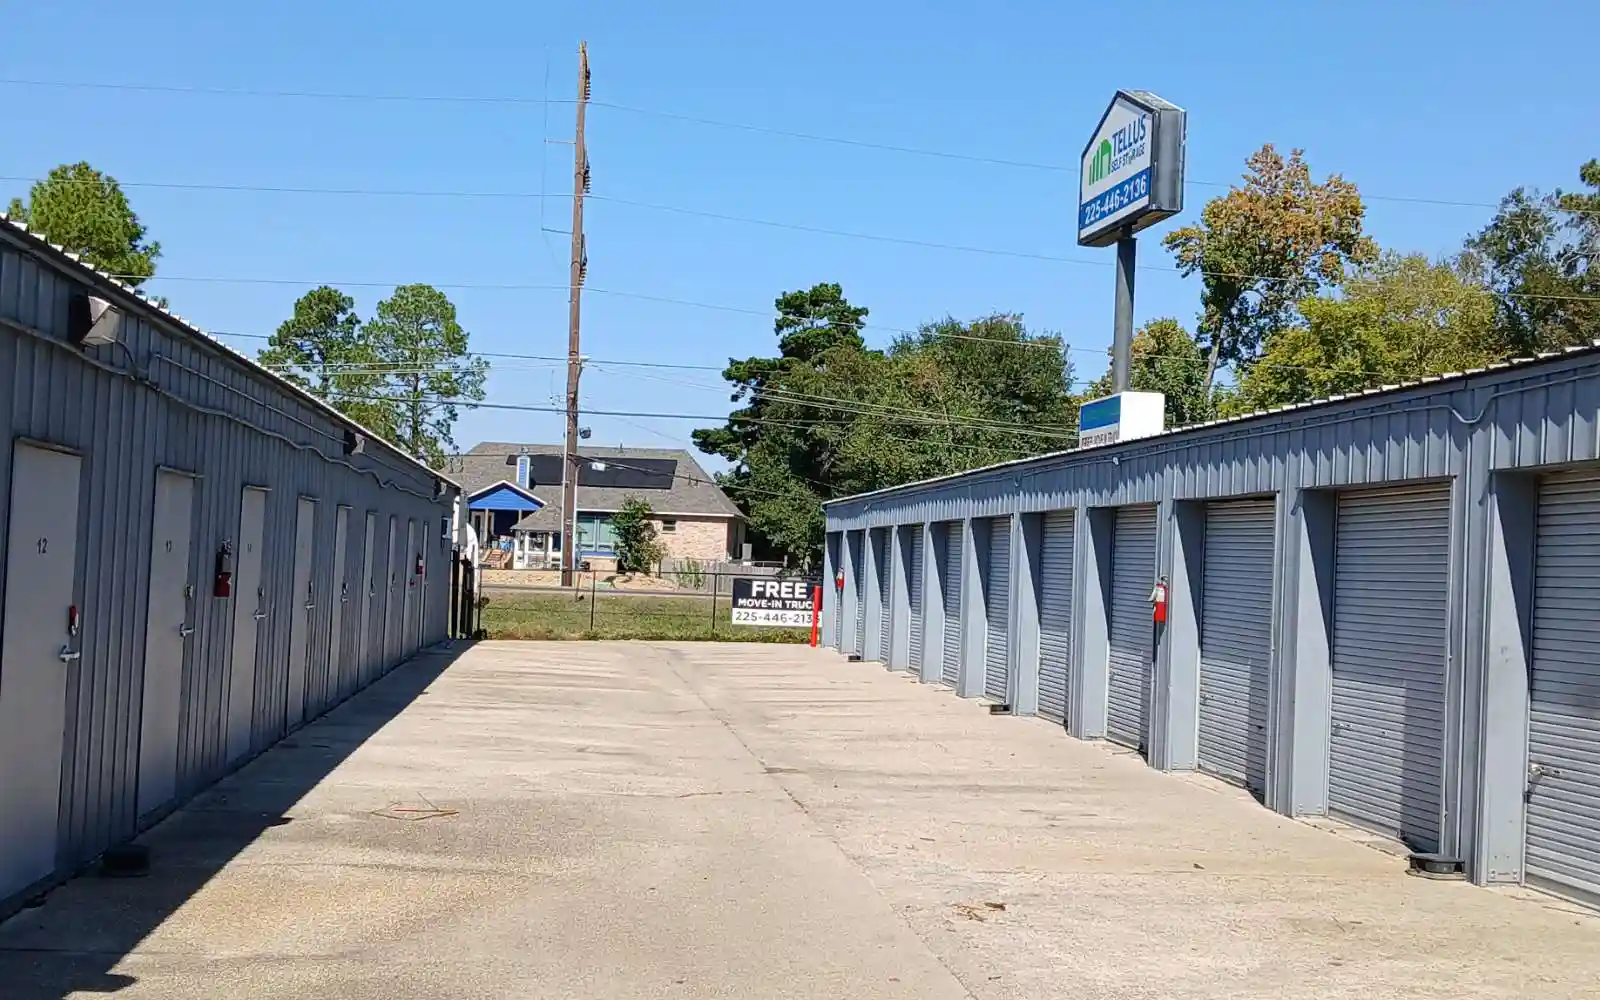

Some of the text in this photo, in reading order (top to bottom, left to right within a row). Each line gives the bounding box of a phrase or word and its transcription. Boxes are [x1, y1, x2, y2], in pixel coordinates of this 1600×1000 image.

[1111, 113, 1146, 157] TELLUS
[1111, 156, 1122, 173] SELF
[1084, 174, 1147, 225] 225-446-2136
[37, 537, 48, 555] 12
[751, 580, 808, 599] FREE
[738, 598, 814, 610] MOVE-IN TRUC
[735, 611, 820, 624] 225-446-213
